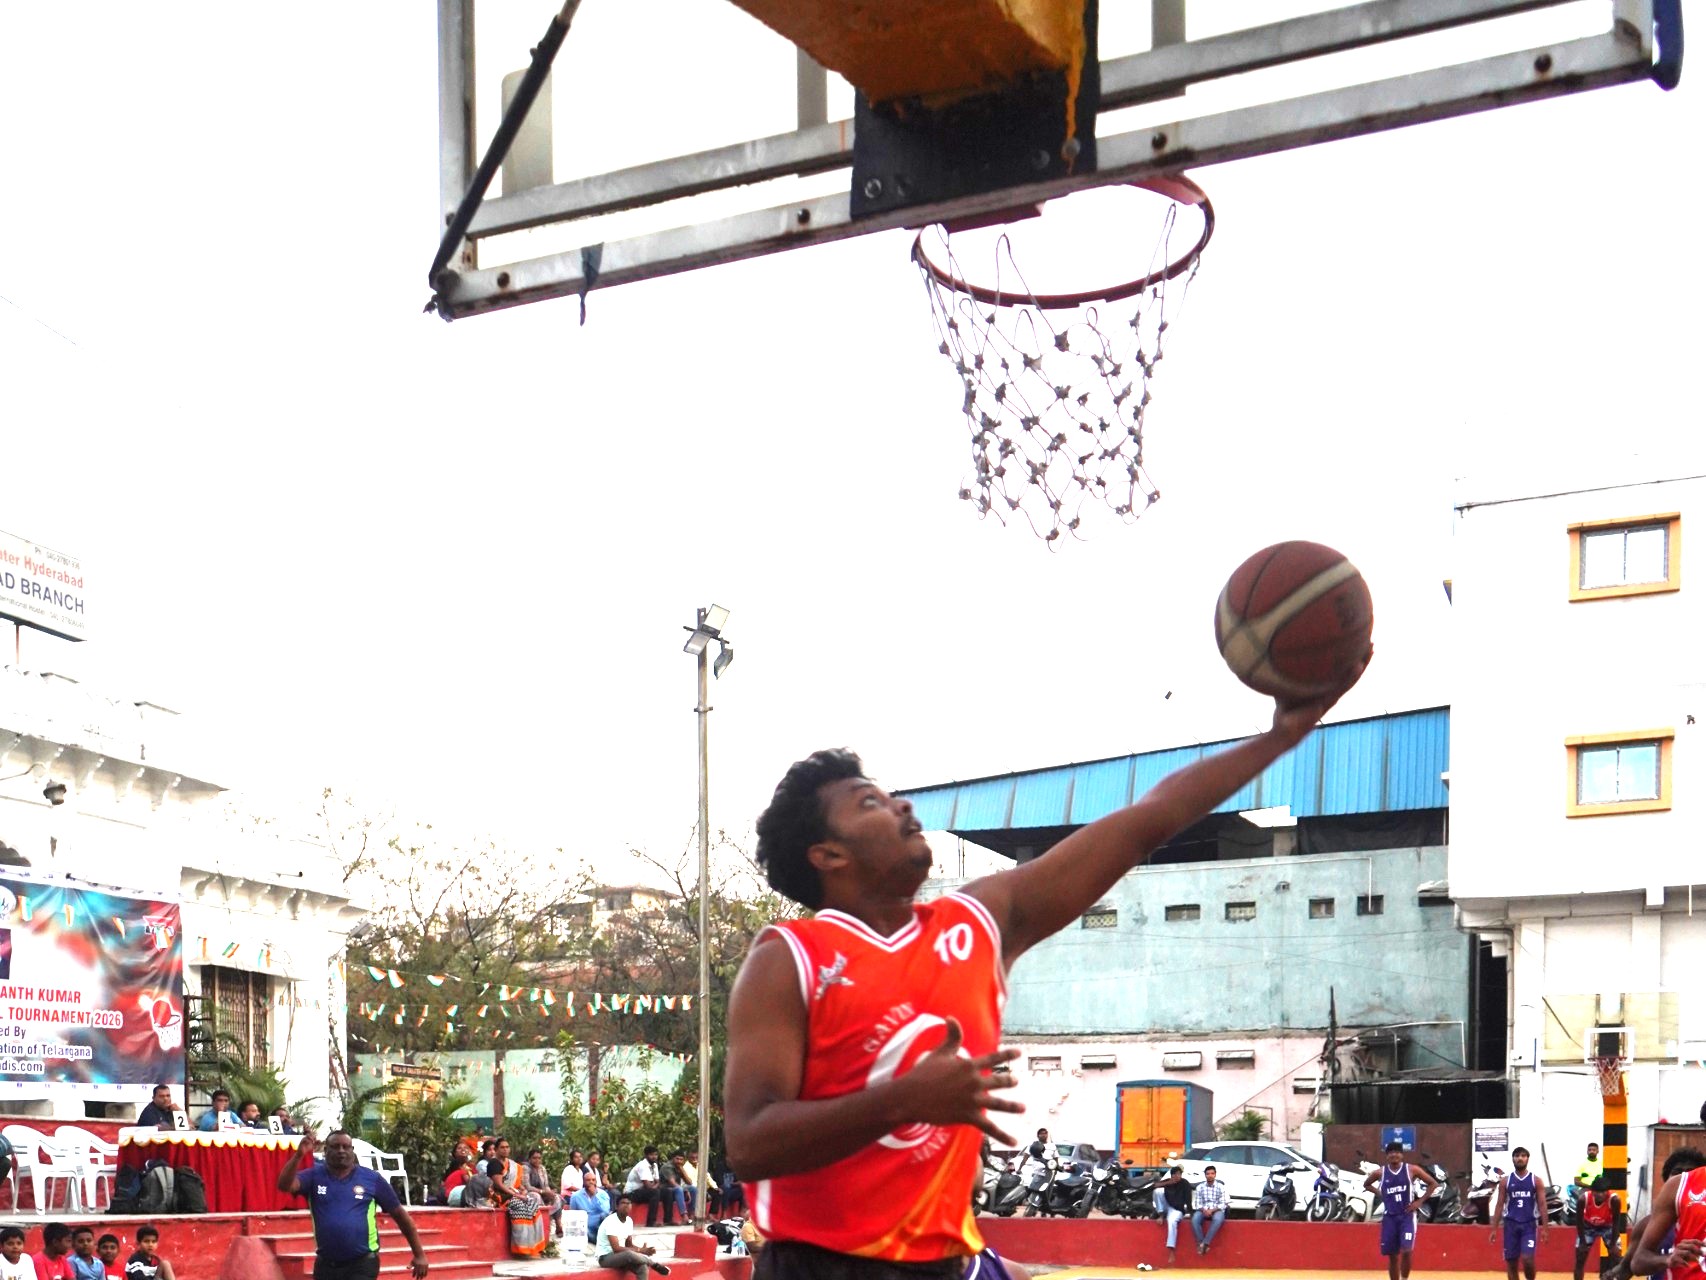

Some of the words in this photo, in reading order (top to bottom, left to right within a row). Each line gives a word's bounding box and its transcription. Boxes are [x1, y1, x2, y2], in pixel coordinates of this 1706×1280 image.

[24, 555, 84, 589] Hyderabad
[20, 577, 84, 614] BRANCH
[933, 922, 974, 965] 10
[38, 988, 81, 1004] KUMAR
[8, 1006, 91, 1024] TOURNAMENT
[94, 1012, 122, 1027] 2026
[14, 1025, 26, 1040] By
[27, 1043, 38, 1055] of
[42, 1044, 91, 1058] Telangana
[0, 1059, 43, 1072] dis.com
[178, 1115, 186, 1128] 2
[272, 1120, 280, 1132] 3
[1517, 1199, 1524, 1208] 3
[1527, 1239, 1535, 1248] 3
